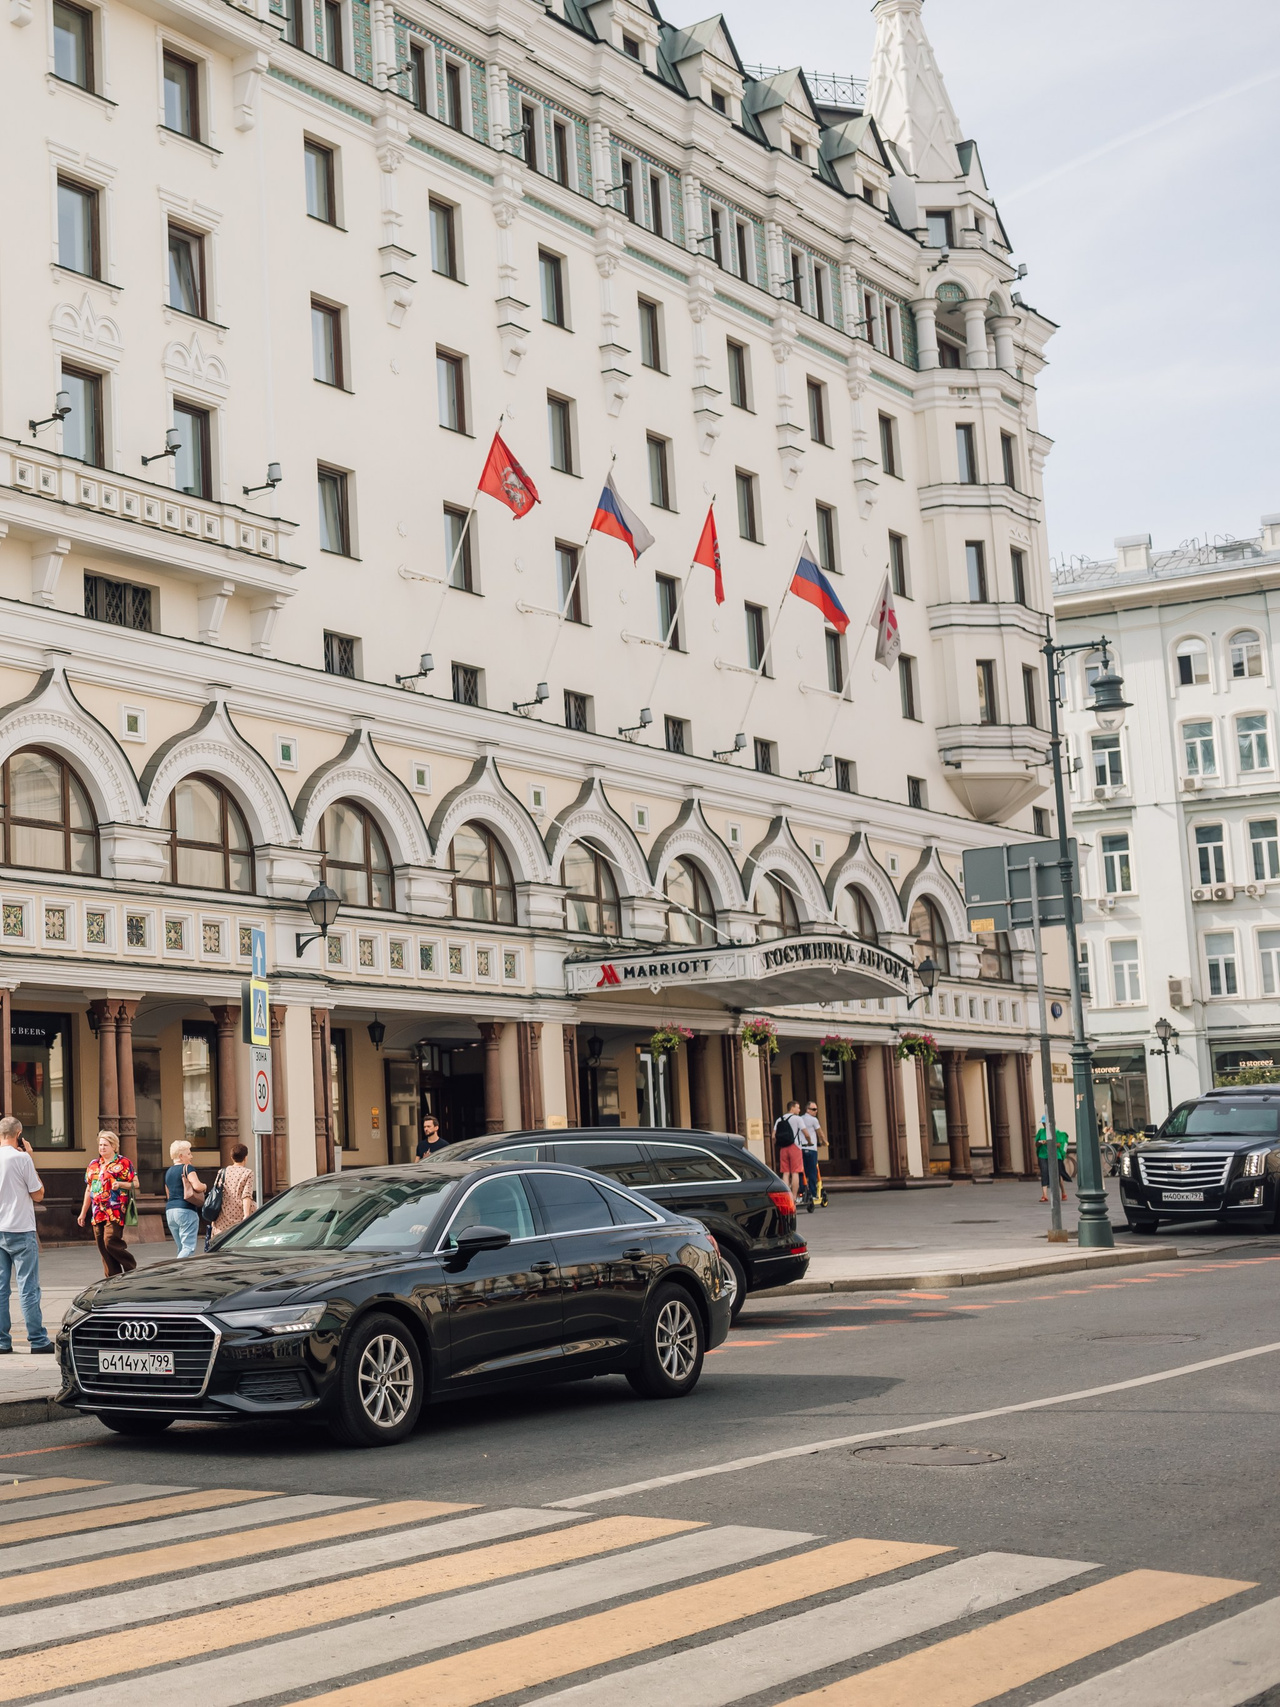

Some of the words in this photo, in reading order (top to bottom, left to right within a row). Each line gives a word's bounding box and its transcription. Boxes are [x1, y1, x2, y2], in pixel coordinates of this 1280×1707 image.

[623, 959, 711, 979] MARRIOTT
[763, 942, 855, 970] ГОСТИНИЦА
[858, 947, 910, 985] АВРОРА
[18, 1026, 46, 1036] BEERS
[1094, 1066, 1121, 1074] storeez
[1246, 1059, 1274, 1067] storeez
[258, 1083, 267, 1100] 30
[149, 1354, 170, 1368] 799
